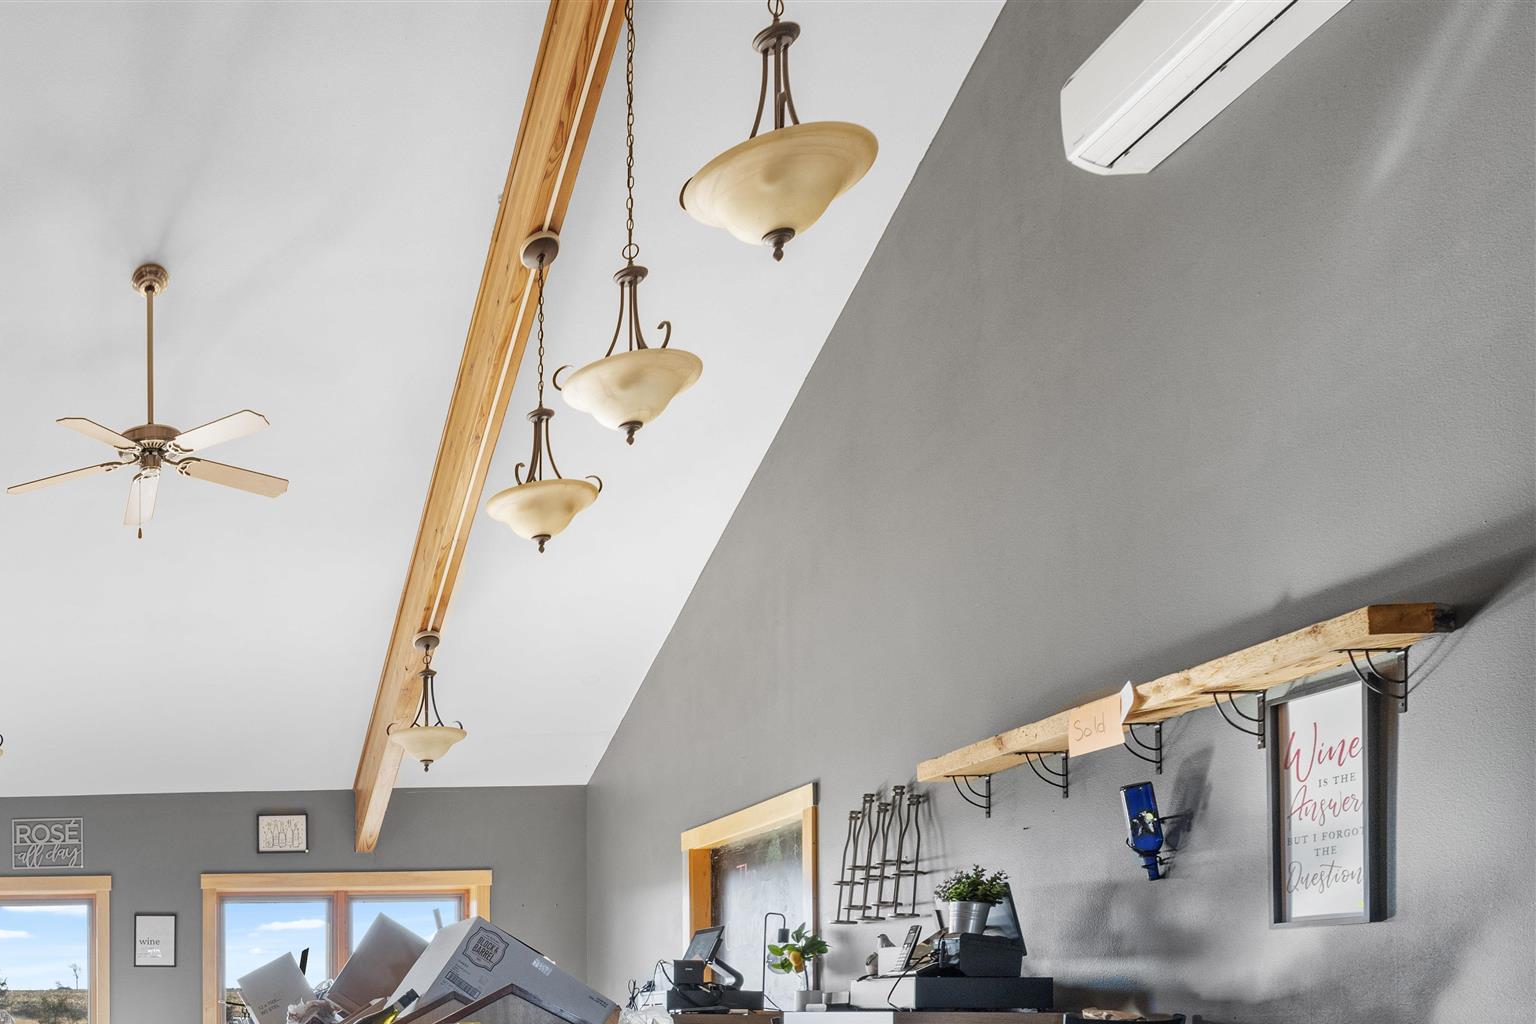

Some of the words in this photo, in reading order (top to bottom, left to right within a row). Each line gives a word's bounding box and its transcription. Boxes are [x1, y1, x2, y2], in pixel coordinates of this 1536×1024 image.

[1074, 712, 1105, 742] Sold
[1283, 722, 1364, 783] Wine
[1318, 778, 1329, 788] IS
[1332, 772, 1358, 786] THE
[1286, 784, 1364, 828] Answer
[15, 819, 80, 845] ROSÉ
[1287, 834, 1308, 847] BUT
[1313, 833, 1318, 843] I
[14, 842, 44, 868] all
[45, 842, 82, 868] day
[1314, 846, 1337, 858] THE
[1286, 860, 1363, 894] Question
[139, 937, 161, 946] wine
